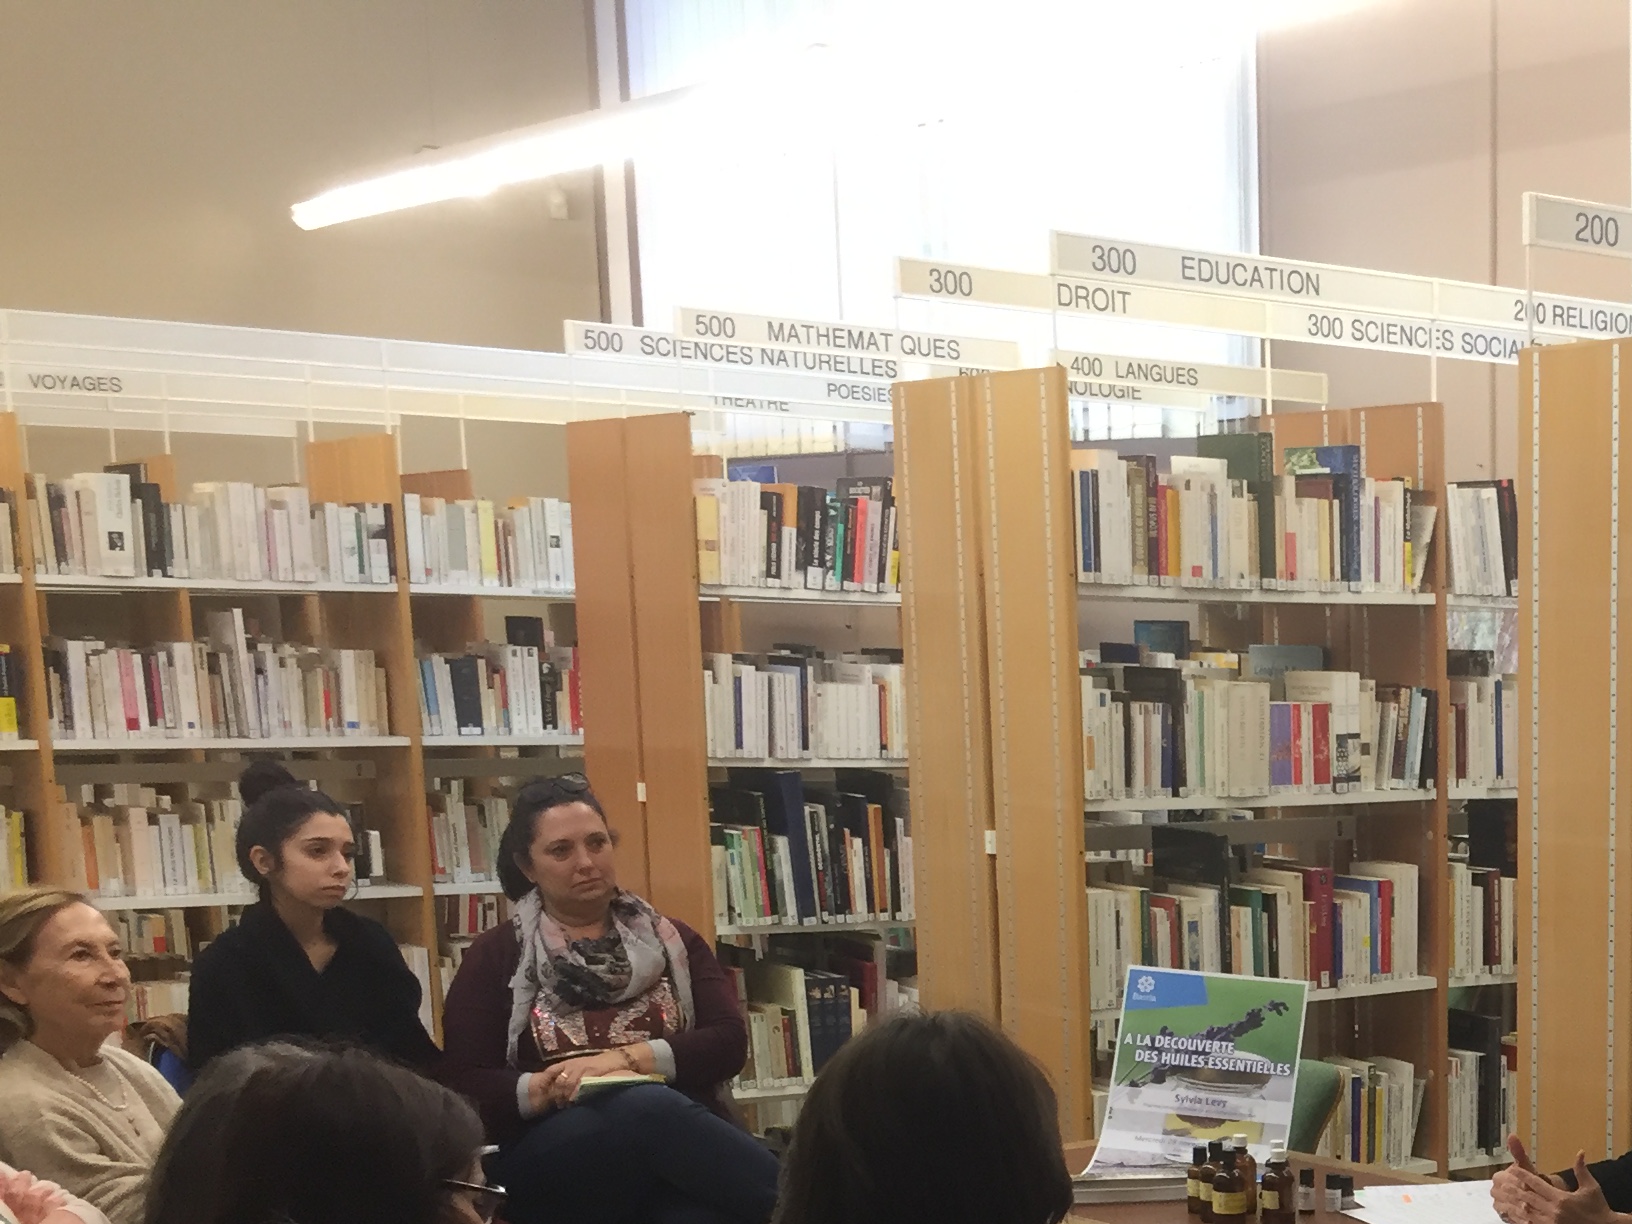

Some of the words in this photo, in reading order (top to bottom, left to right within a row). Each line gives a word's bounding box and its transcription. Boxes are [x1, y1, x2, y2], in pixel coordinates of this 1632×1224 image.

[1574, 212, 1619, 248] 200
[1091, 244, 1137, 275] 300
[1181, 255, 1320, 297] EDUCATION
[928, 267, 973, 297] 300
[1057, 282, 1131, 314] DROIT
[1514, 300, 1546, 324] 200
[695, 314, 736, 339] 500
[767, 320, 961, 361] MATHEMATQUES
[1308, 313, 1343, 340] 300
[1351, 319, 1454, 352] SCIENCES
[1461, 332, 1541, 359] SOCIA
[584, 329, 623, 353] 500
[640, 335, 754, 365] SCIENCES
[760, 348, 898, 379] NATURELLES
[28, 374, 123, 393] VOYAGES
[1070, 356, 1103, 378] 400
[1115, 361, 1199, 386] LANGUES
[826, 382, 894, 403] POESIES
[1124, 1032, 1133, 1045] A
[1136, 1033, 1151, 1047] LA
[1154, 1035, 1235, 1055] DECOUVERTE
[1134, 1049, 1158, 1064] DES
[1161, 1051, 1205, 1069] HUILES
[1208, 1056, 1291, 1077] ESSENTIELLES
